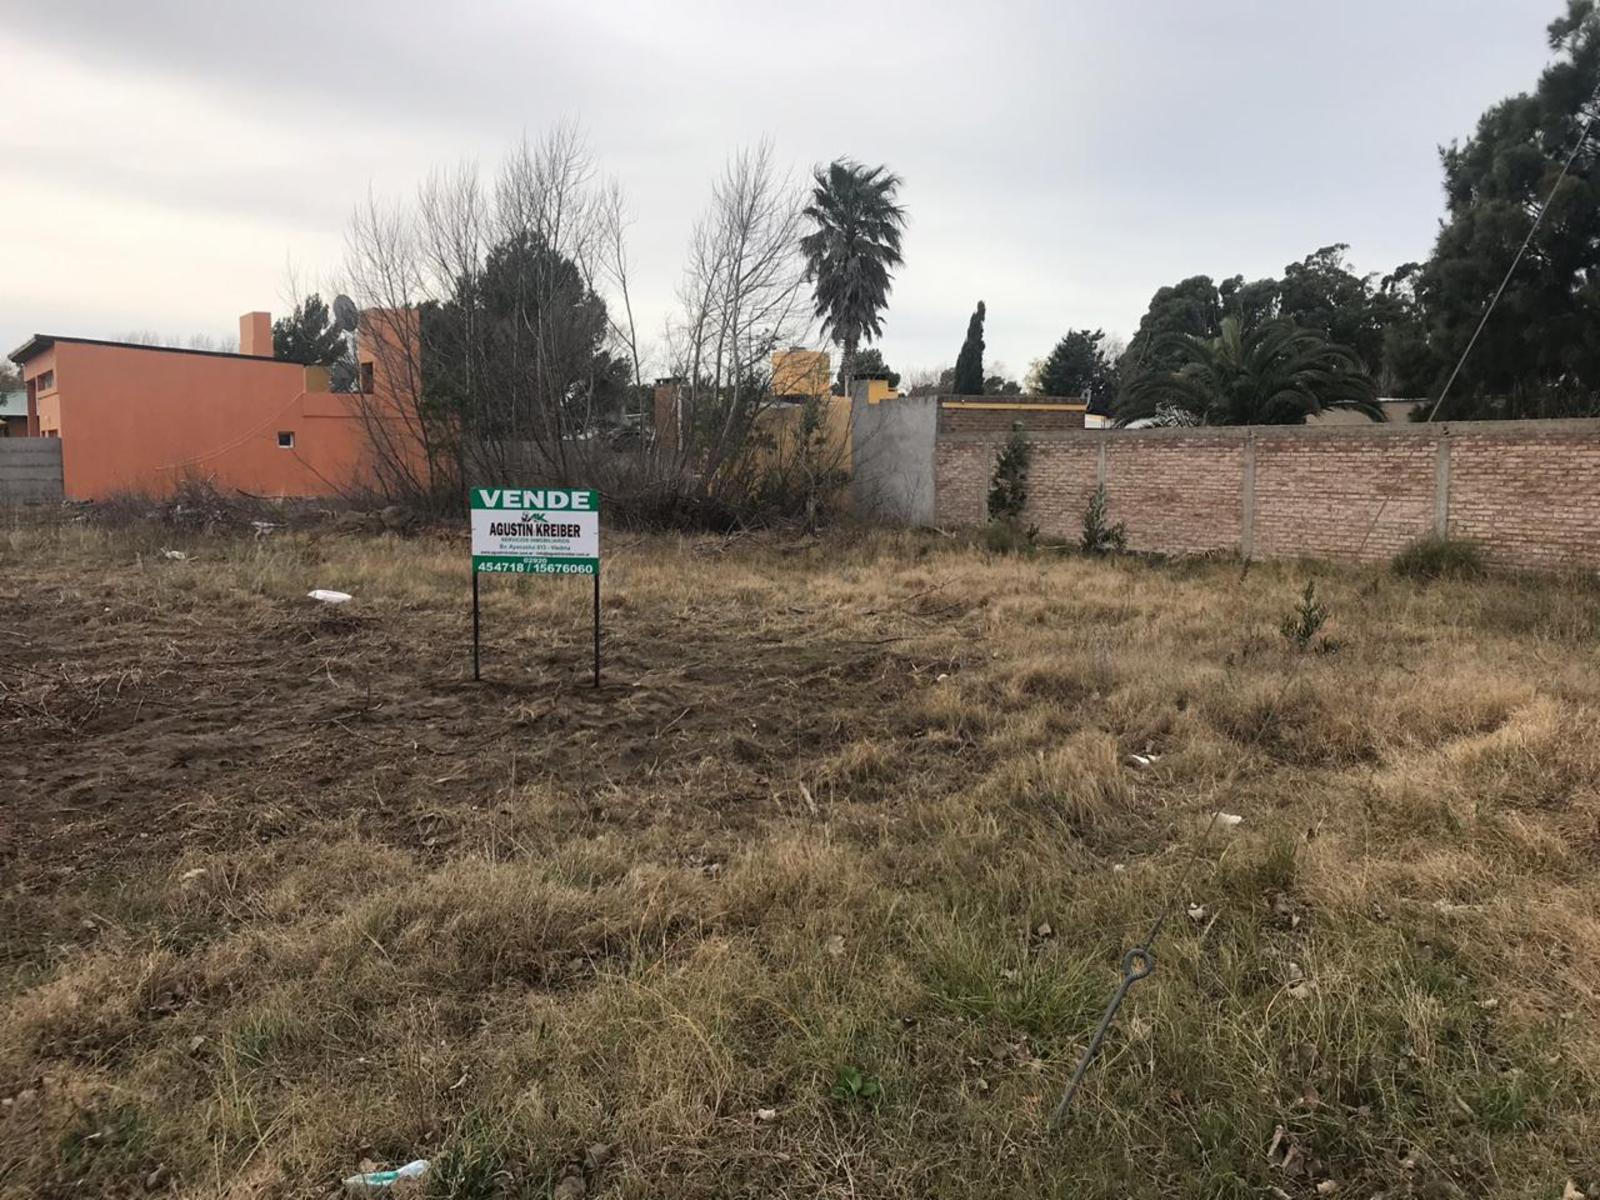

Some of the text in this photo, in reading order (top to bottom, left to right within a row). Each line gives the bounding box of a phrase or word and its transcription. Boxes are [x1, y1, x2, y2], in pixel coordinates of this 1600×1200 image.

[479, 490, 590, 509] VENDE
[489, 522, 581, 537] AGUSTIN KREIBER
[478, 562, 524, 572] 454718
[534, 563, 593, 573] 15676060
